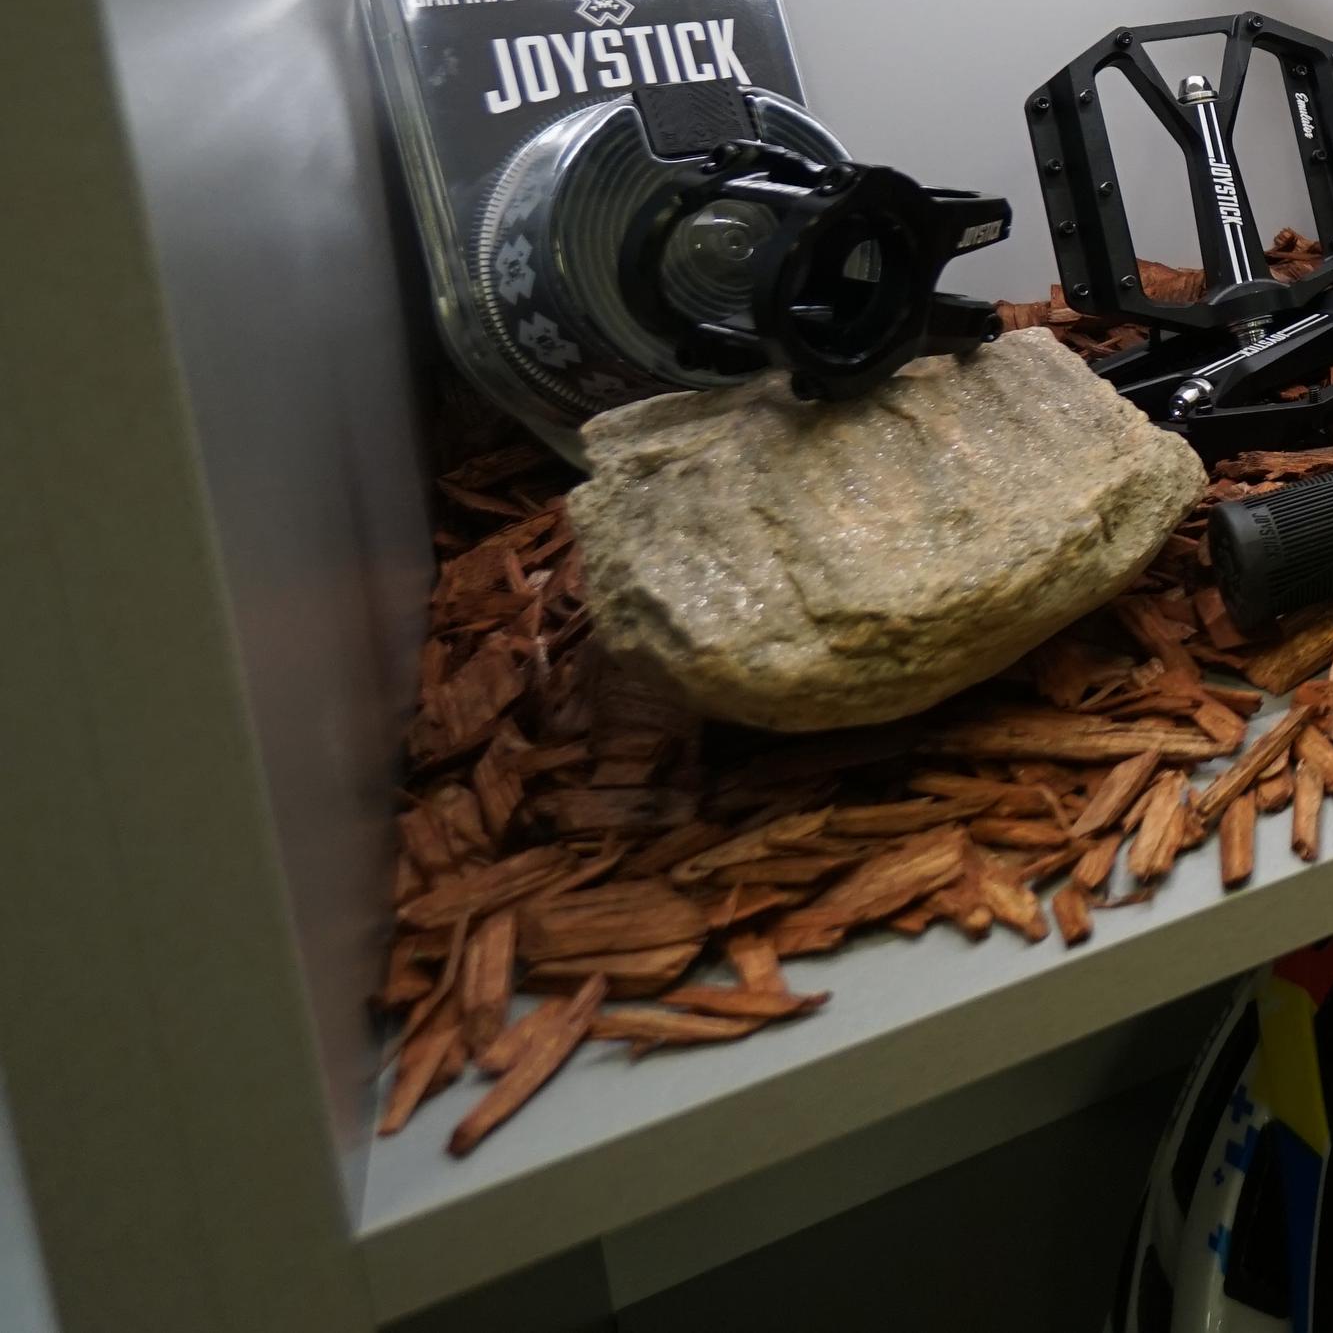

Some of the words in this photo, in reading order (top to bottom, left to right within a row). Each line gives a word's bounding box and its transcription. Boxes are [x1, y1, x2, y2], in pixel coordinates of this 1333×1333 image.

[484, 18, 752, 115] JOYSTICK
[1295, 92, 1314, 140] Emulator
[1209, 156, 1244, 226] JOYSTICK
[1237, 330, 1290, 357] JOYSTICK
